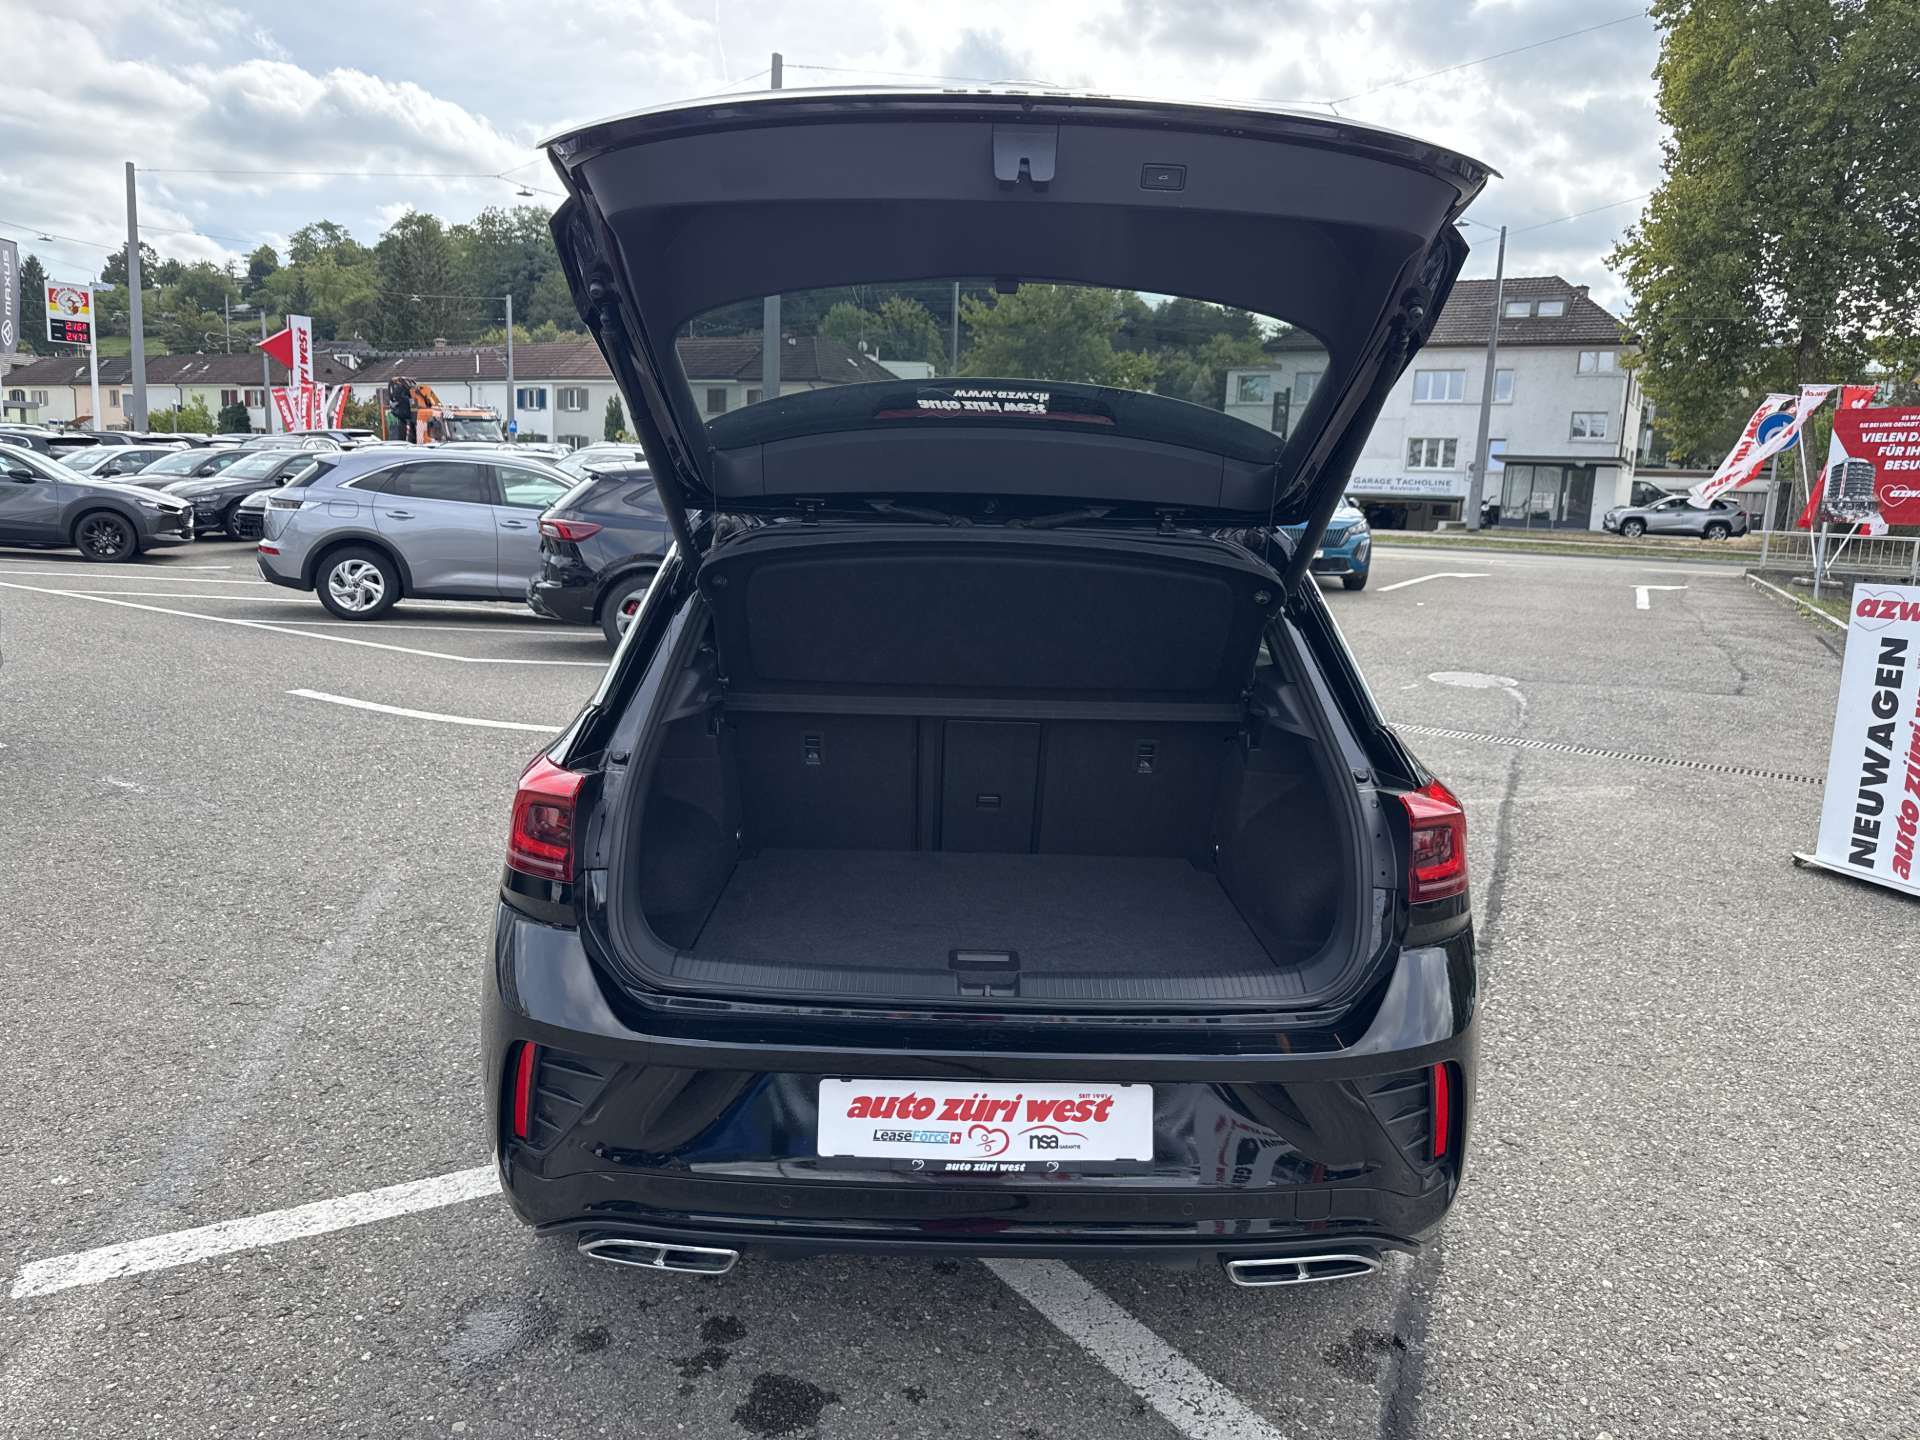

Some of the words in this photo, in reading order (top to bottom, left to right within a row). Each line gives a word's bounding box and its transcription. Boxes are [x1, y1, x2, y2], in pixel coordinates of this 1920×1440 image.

[3, 249, 12, 316] MAXUS
[297, 327, 309, 365] west
[1861, 432, 1907, 443] VIELEN
[1908, 431, 1920, 442] D
[1877, 444, 1905, 456] FÜR
[1883, 459, 1920, 471] BESU
[1353, 477, 1393, 485] GARAGE
[1396, 478, 1453, 487] TACHOLINE
[1856, 598, 1920, 622] azw
[1848, 637, 1909, 869] NEUWAGEN
[1892, 799, 1920, 881] auto
[846, 1091, 936, 1121] auto
[936, 1093, 1023, 1122] züri
[1026, 1094, 1115, 1122] west
[873, 1129, 949, 1143] LeaseForce
[1029, 1134, 1059, 1149] nsa
[944, 1161, 971, 1171] auto
[973, 1161, 998, 1172] züri
[999, 1161, 1026, 1172] west
